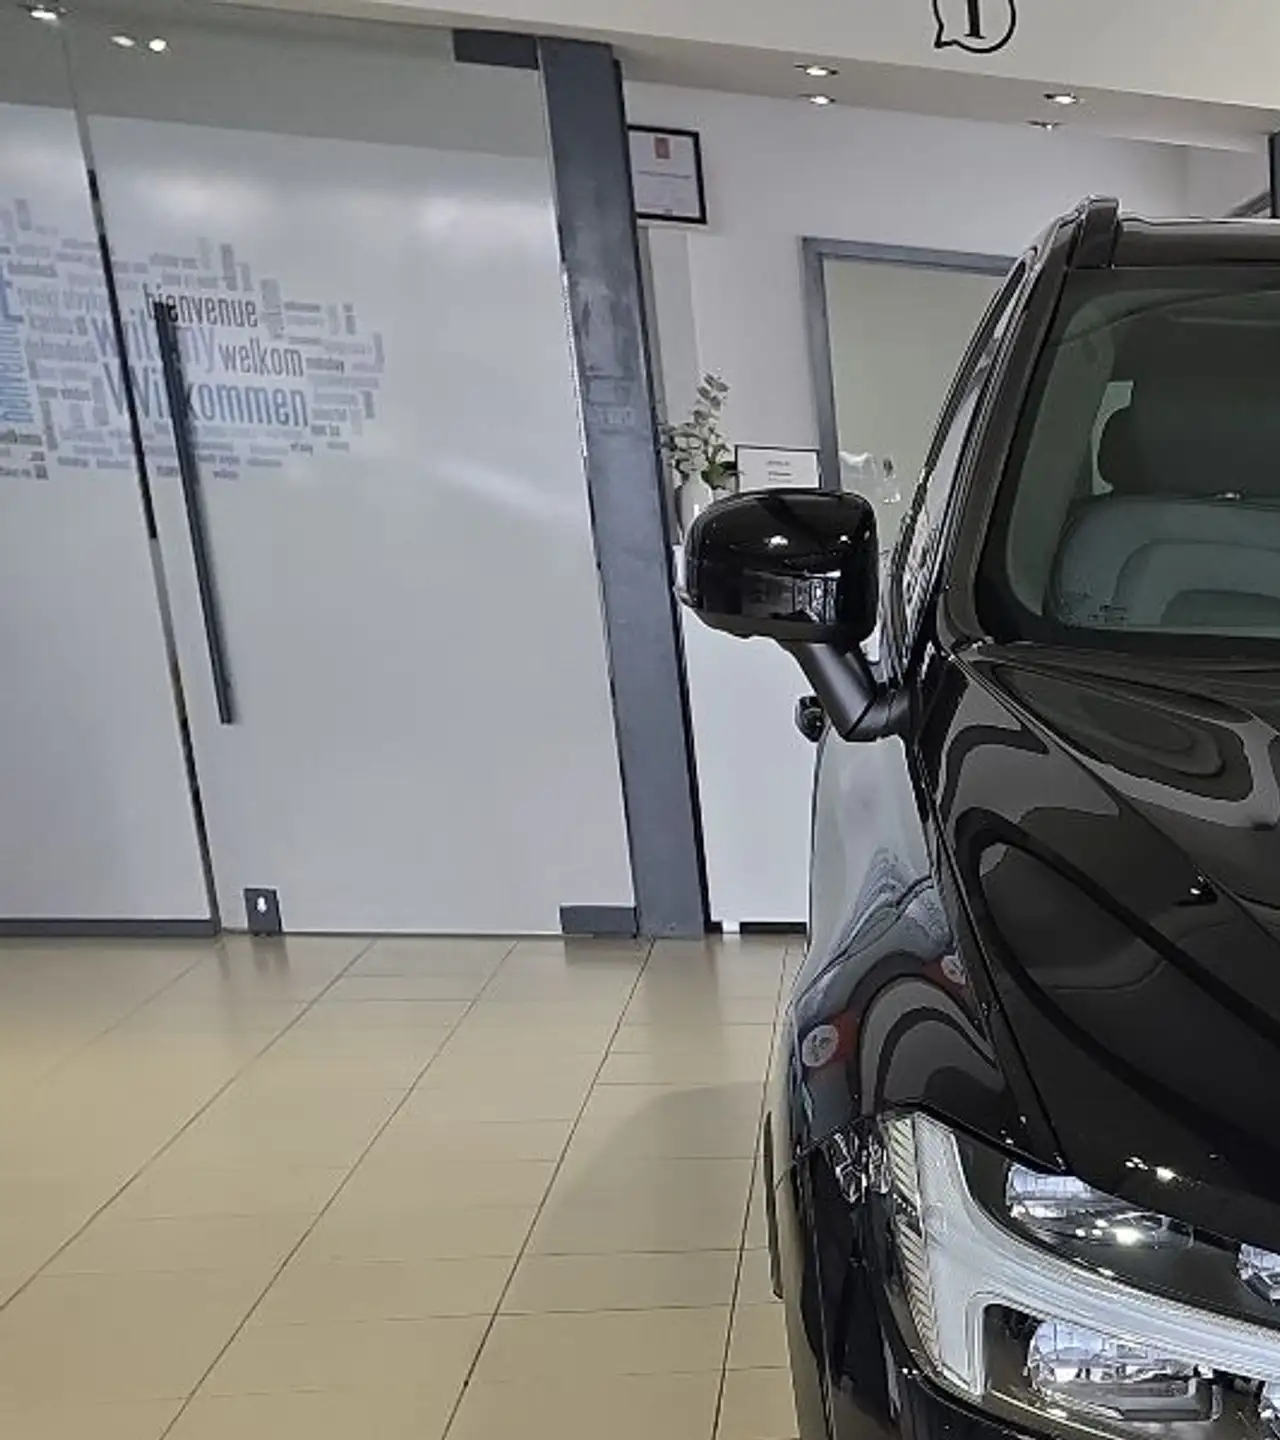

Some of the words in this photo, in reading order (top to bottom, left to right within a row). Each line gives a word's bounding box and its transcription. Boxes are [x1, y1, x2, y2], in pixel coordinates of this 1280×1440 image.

[143, 282, 258, 328] bienvenue
[219, 336, 305, 377] welkom
[102, 362, 310, 429] Wikommen
